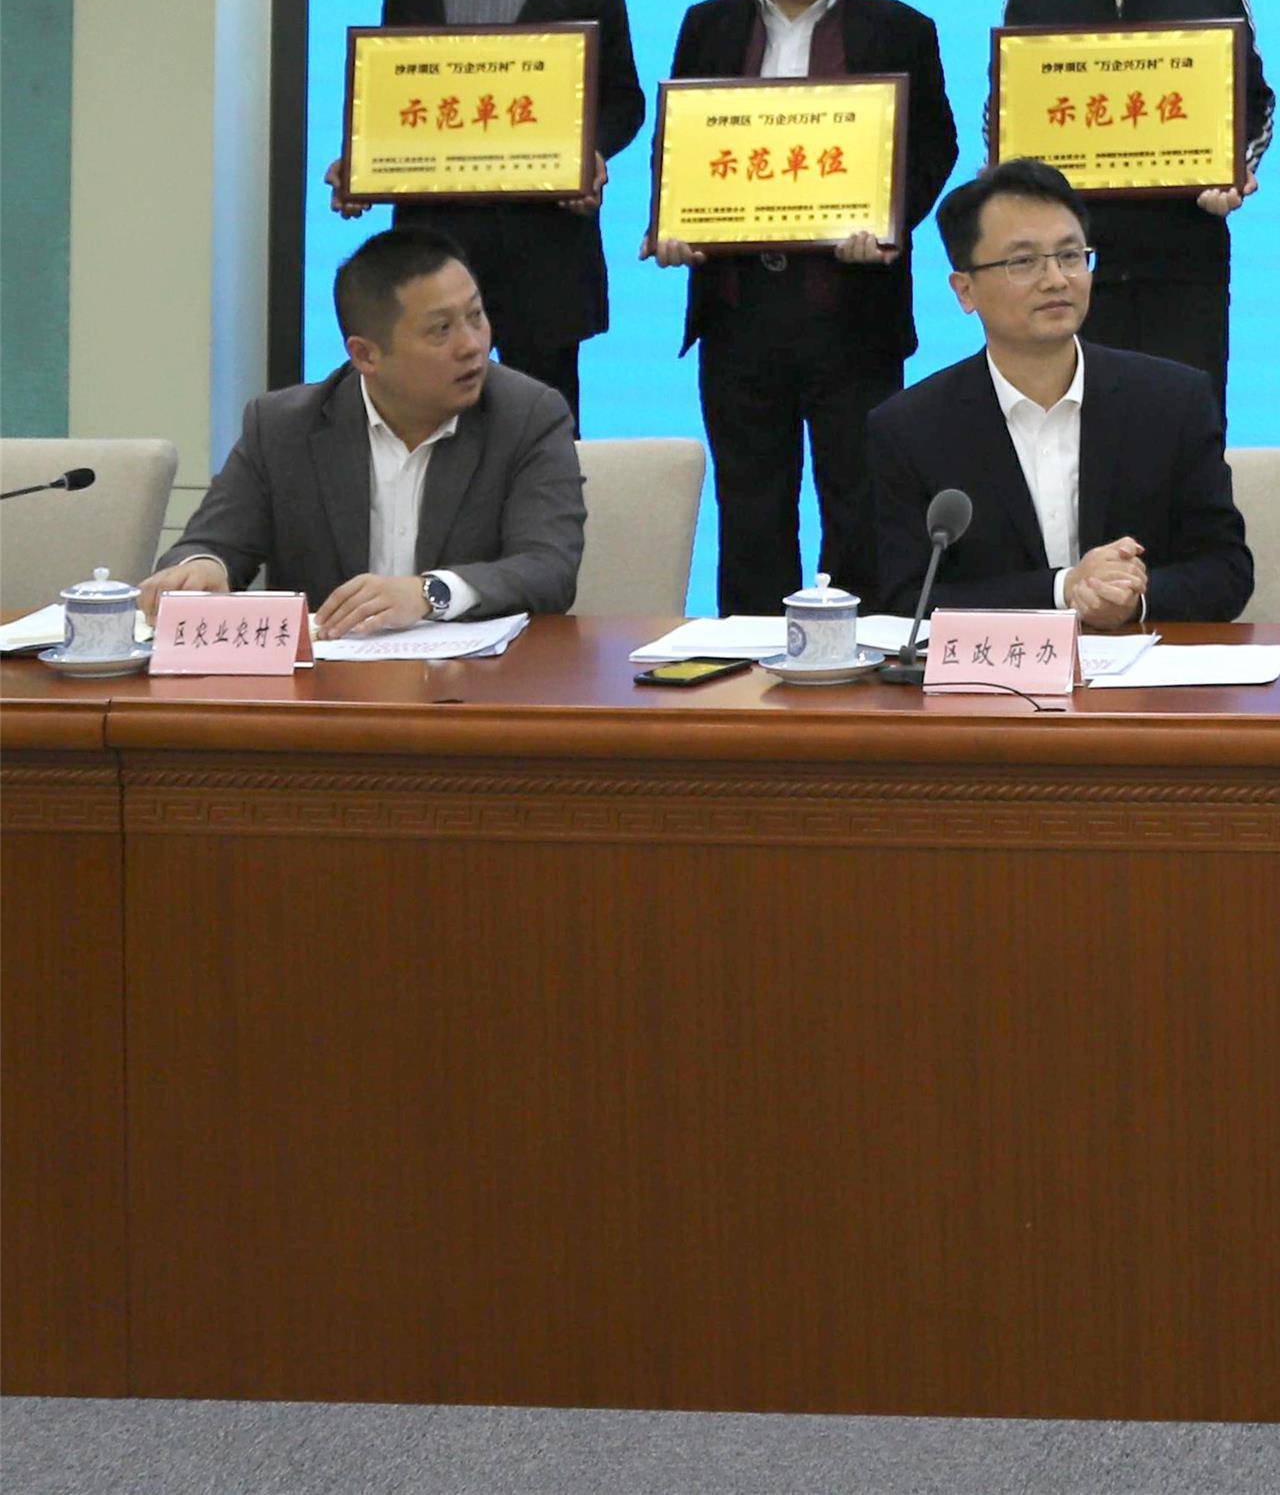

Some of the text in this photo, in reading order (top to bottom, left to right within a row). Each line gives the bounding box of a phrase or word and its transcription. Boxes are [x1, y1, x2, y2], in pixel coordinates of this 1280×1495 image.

[400, 94, 538, 132] 示范单位
[1047, 90, 1187, 129] 示范单位
[709, 145, 848, 182] 示范单位
[174, 616, 291, 648] 区农业农村委
[942, 636, 1057, 668] 区政府办
